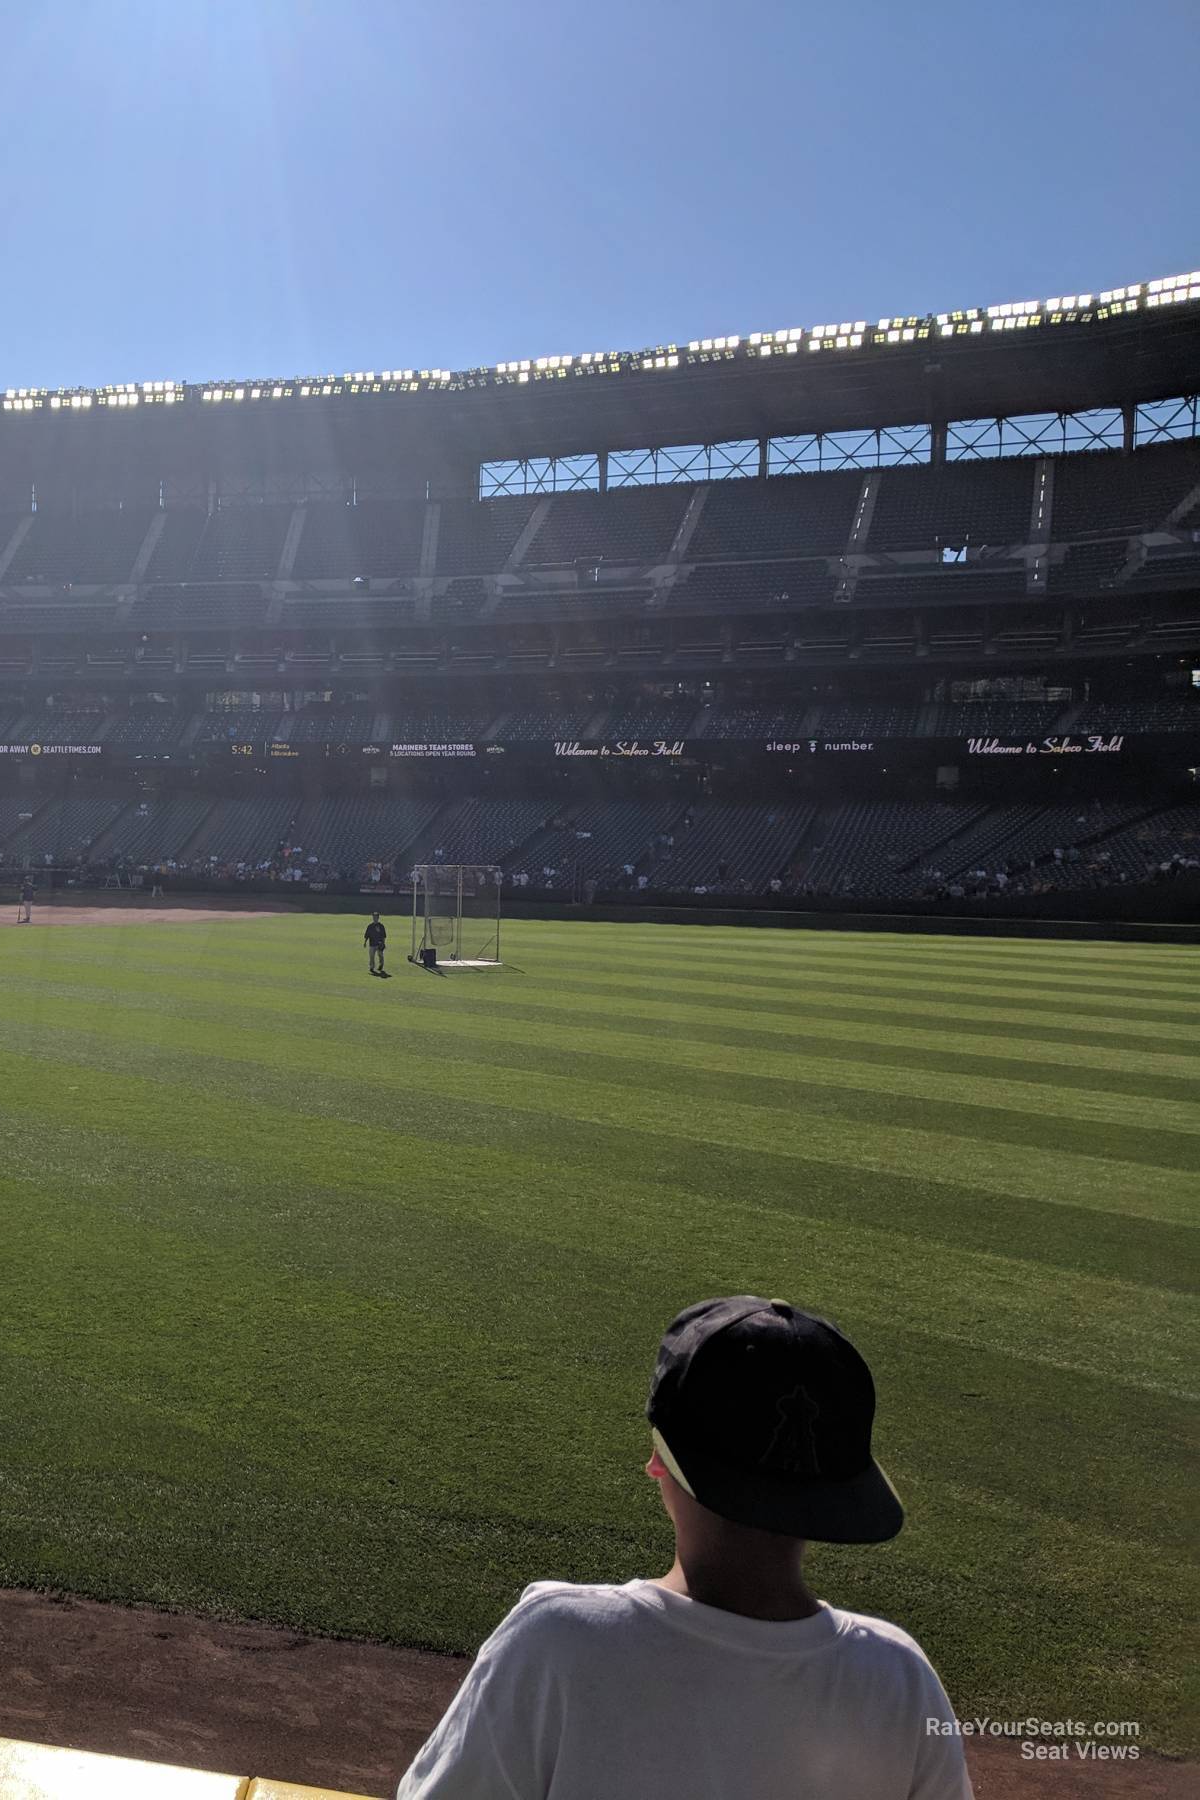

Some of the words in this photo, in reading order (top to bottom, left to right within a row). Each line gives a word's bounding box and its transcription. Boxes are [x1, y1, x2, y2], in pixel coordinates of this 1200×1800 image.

[0, 745, 8, 754] OR
[10, 745, 29, 754] AWAY
[43, 745, 101, 754] SEATTLETIMES.COM
[231, 745, 253, 755] 5:42
[554, 742, 598, 756] Welcome
[601, 745, 610, 755] to
[612, 741, 649, 756] Safeco
[651, 741, 685, 756] Field
[766, 741, 801, 753] sleep
[967, 738, 1023, 754] Welcome
[1026, 742, 1037, 754] to
[1040, 737, 1082, 754] Safeco
[1085, 736, 1124, 753] Field
